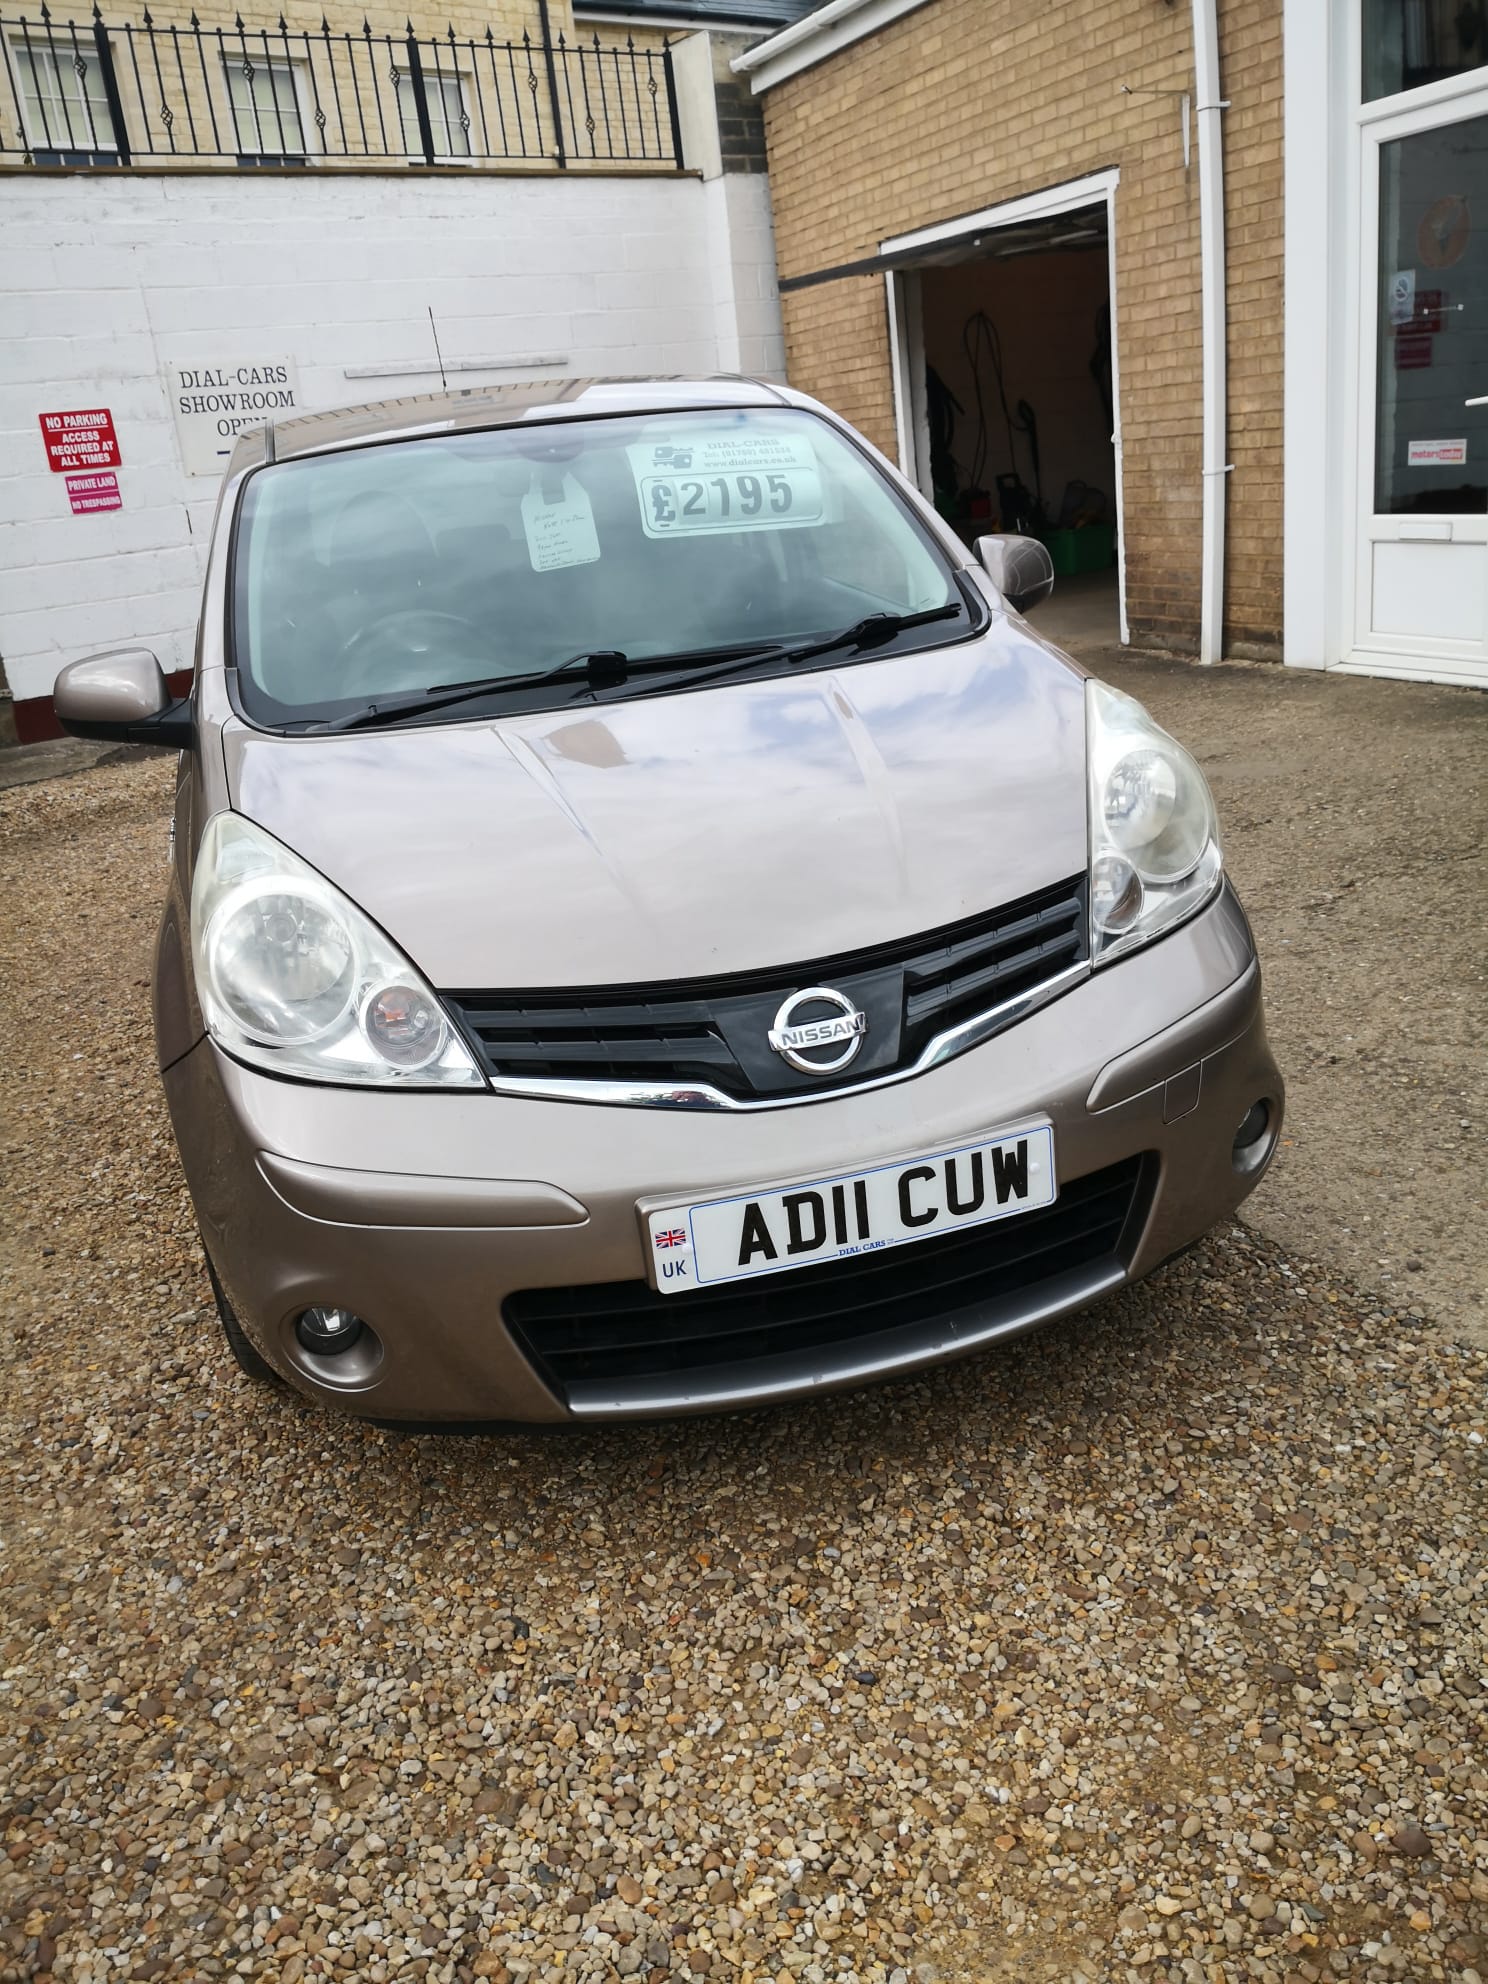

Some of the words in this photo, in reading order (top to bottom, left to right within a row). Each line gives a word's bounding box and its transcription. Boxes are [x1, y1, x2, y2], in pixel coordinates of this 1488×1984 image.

[178, 366, 288, 389] DIAL-CARS
[179, 390, 296, 414] SHOWROOM
[45, 416, 61, 428] NO
[63, 413, 108, 427] PARKING
[217, 416, 268, 437] OP
[62, 430, 100, 443] ACCESS
[50, 442, 100, 456] REQUIRED
[102, 440, 114, 451] AT
[61, 456, 80, 467] ALL
[80, 452, 111, 464] TIMES
[67, 478, 97, 491] PRIVATE
[96, 476, 116, 488] LAND
[651, 473, 793, 523] £2195
[781, 1018, 860, 1046] NISSAN
[737, 1180, 871, 1266] AD11
[897, 1139, 1028, 1228] CUW
[838, 1246, 862, 1257] DIAL
[863, 1240, 887, 1251] CARS
[662, 1260, 687, 1278] UK
